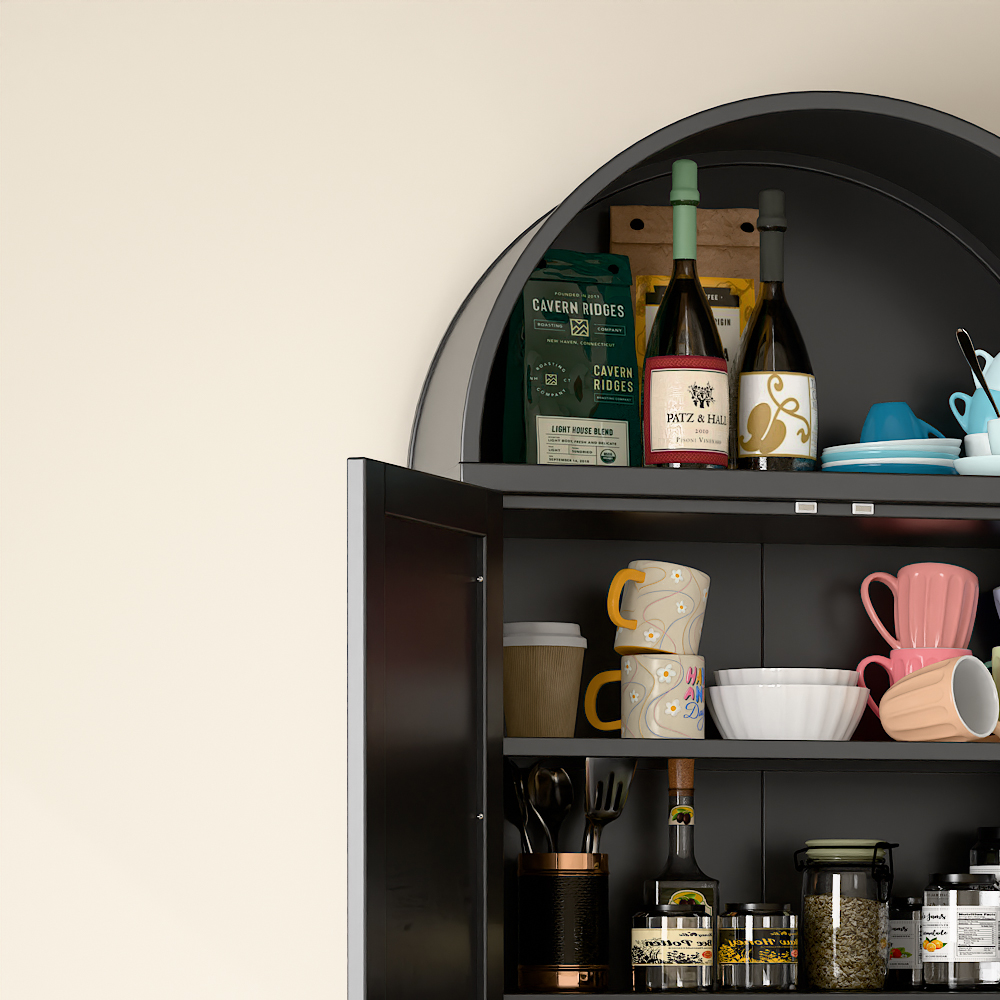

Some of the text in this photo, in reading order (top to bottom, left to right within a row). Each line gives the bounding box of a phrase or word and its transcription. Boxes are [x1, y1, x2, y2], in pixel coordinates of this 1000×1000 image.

[532, 298, 625, 318] CAVERN RIDGES
[536, 361, 566, 373] ROASTING
[593, 364, 633, 379] CAVERN
[594, 379, 634, 392] RIDGES
[536, 387, 566, 397] COMPANY
[667, 413, 694, 423] PATZ
[697, 414, 705, 423] &
[552, 425, 614, 436] LIGHT HOUSE BLEND
